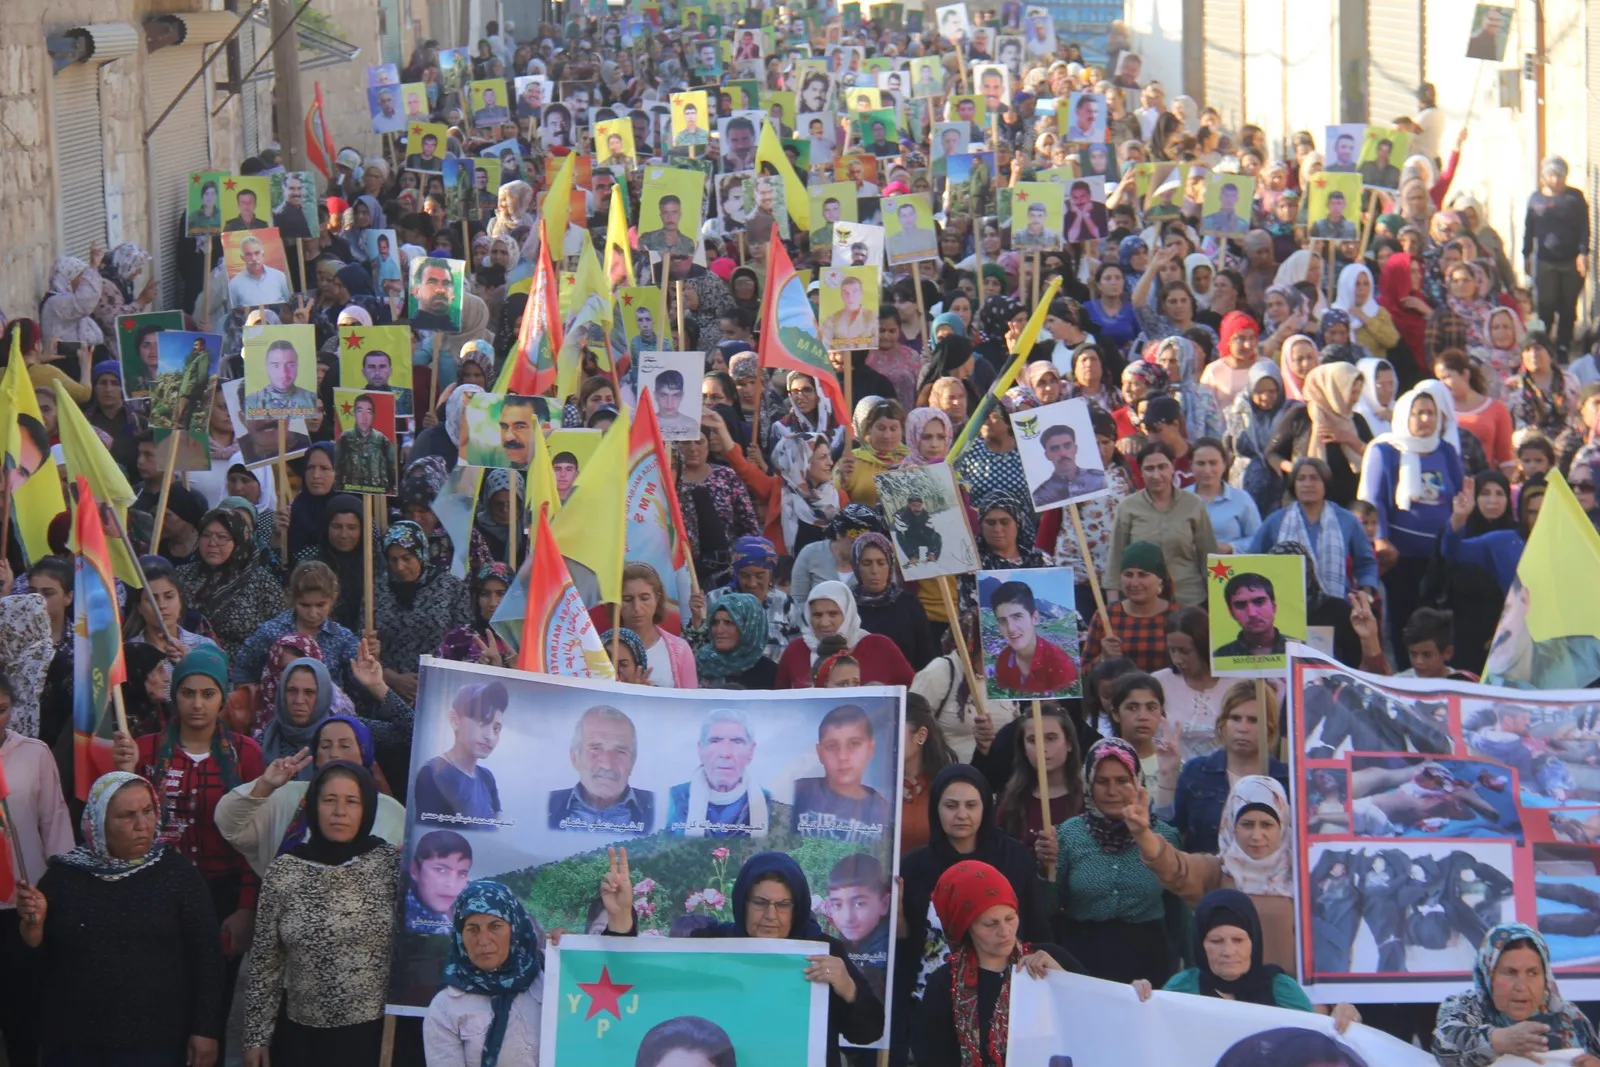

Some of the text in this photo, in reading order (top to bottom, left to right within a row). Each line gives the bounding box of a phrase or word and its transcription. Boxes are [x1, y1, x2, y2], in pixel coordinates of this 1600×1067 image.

[567, 993, 638, 1038] Y P J
